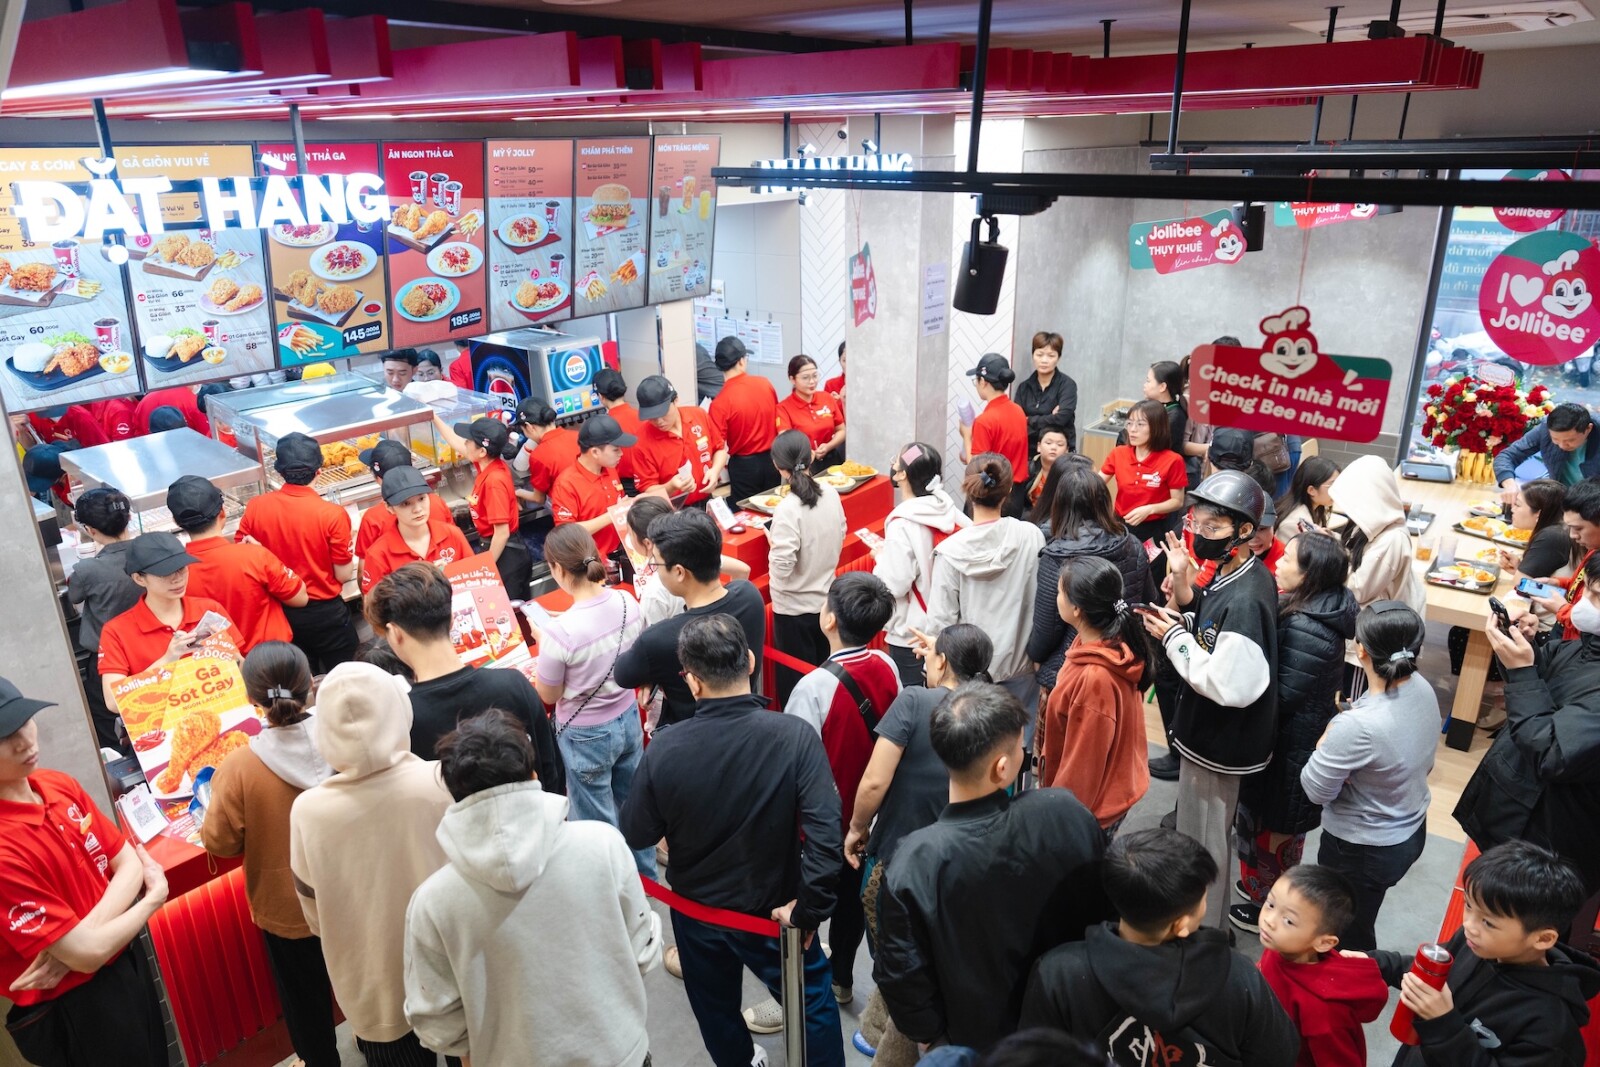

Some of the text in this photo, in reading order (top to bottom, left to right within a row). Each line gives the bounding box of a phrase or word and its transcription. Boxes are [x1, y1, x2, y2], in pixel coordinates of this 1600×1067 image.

[282, 152, 311, 162] NGN
[311, 148, 331, 161] THẢ
[332, 152, 347, 161] GA
[388, 146, 454, 159] ĂN NGON THẢ GA
[512, 148, 536, 157] JOLLY
[122, 154, 140, 168] GÀ
[174, 156, 194, 167] VUI
[528, 166, 537, 174] 50
[9, 153, 391, 264] ĐẶT HÀNG
[1292, 203, 1341, 217] THỤY KHUÊ
[1149, 222, 1203, 240] Jollibee
[1148, 240, 1203, 258] THỤY KHUÊ
[1497, 272, 1510, 304] I
[451, 313, 469, 327] 185
[1489, 306, 1586, 344] Jollibee
[29, 325, 45, 335] 60
[343, 328, 366, 343] 145
[245, 342, 257, 350] 58
[567, 365, 586, 373] PEPSI
[1199, 363, 1382, 417] Check in nhà mới
[1208, 388, 1347, 432] cùng Bee nha!
[195, 664, 221, 682] Gà
[115, 675, 158, 696] Jollibee
[201, 676, 234, 696] Cay
[9, 905, 46, 931] Jollibee
